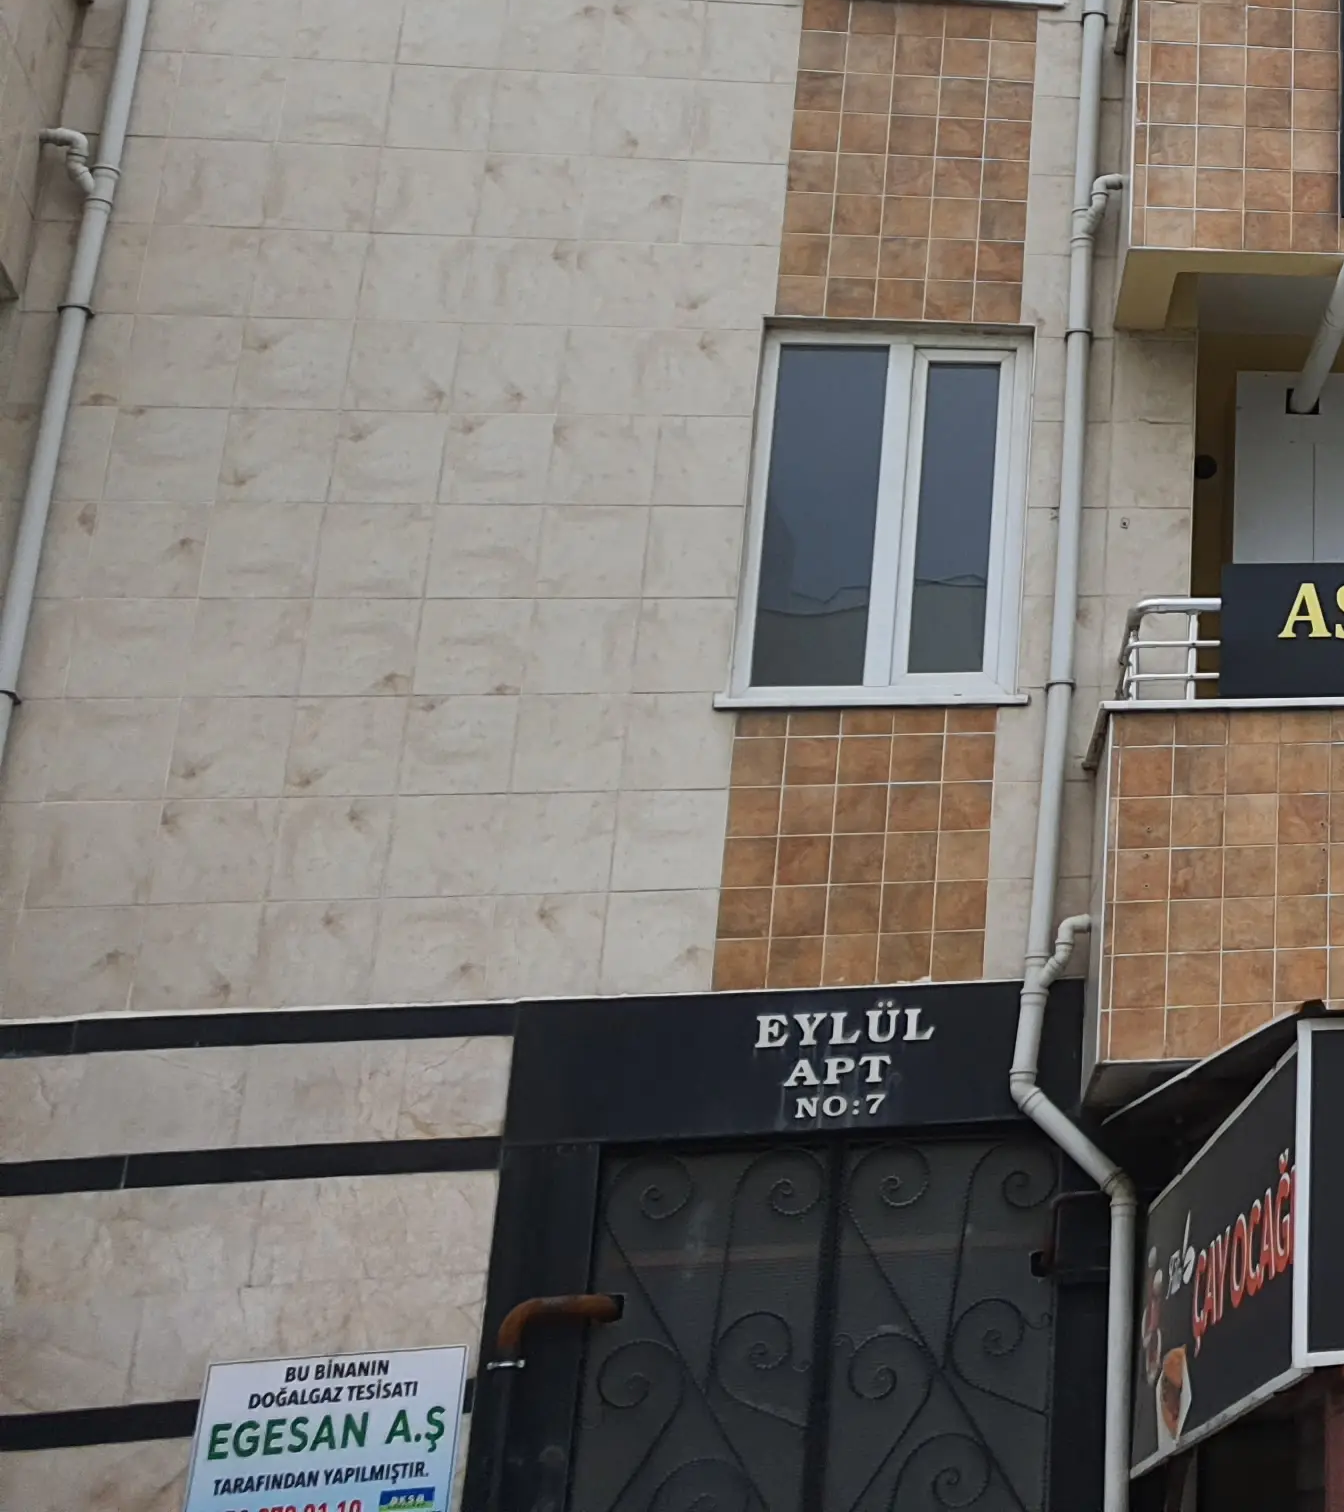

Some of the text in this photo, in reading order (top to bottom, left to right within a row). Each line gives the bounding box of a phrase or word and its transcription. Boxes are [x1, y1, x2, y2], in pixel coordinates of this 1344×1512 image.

[754, 1000, 936, 1049] EYLÜL
[783, 1054, 892, 1088] APT
[794, 1093, 886, 1119] NO:7
[1193, 1224, 1231, 1359] ÇAY
[285, 1358, 390, 1384] BU BİNANIN
[248, 1378, 418, 1410] DOĞALGAZ TESİSATI
[206, 1405, 447, 1461] EGESAN A.Ş
[212, 1461, 430, 1497] TARAFINDAN YAPILMIŞTIR.
